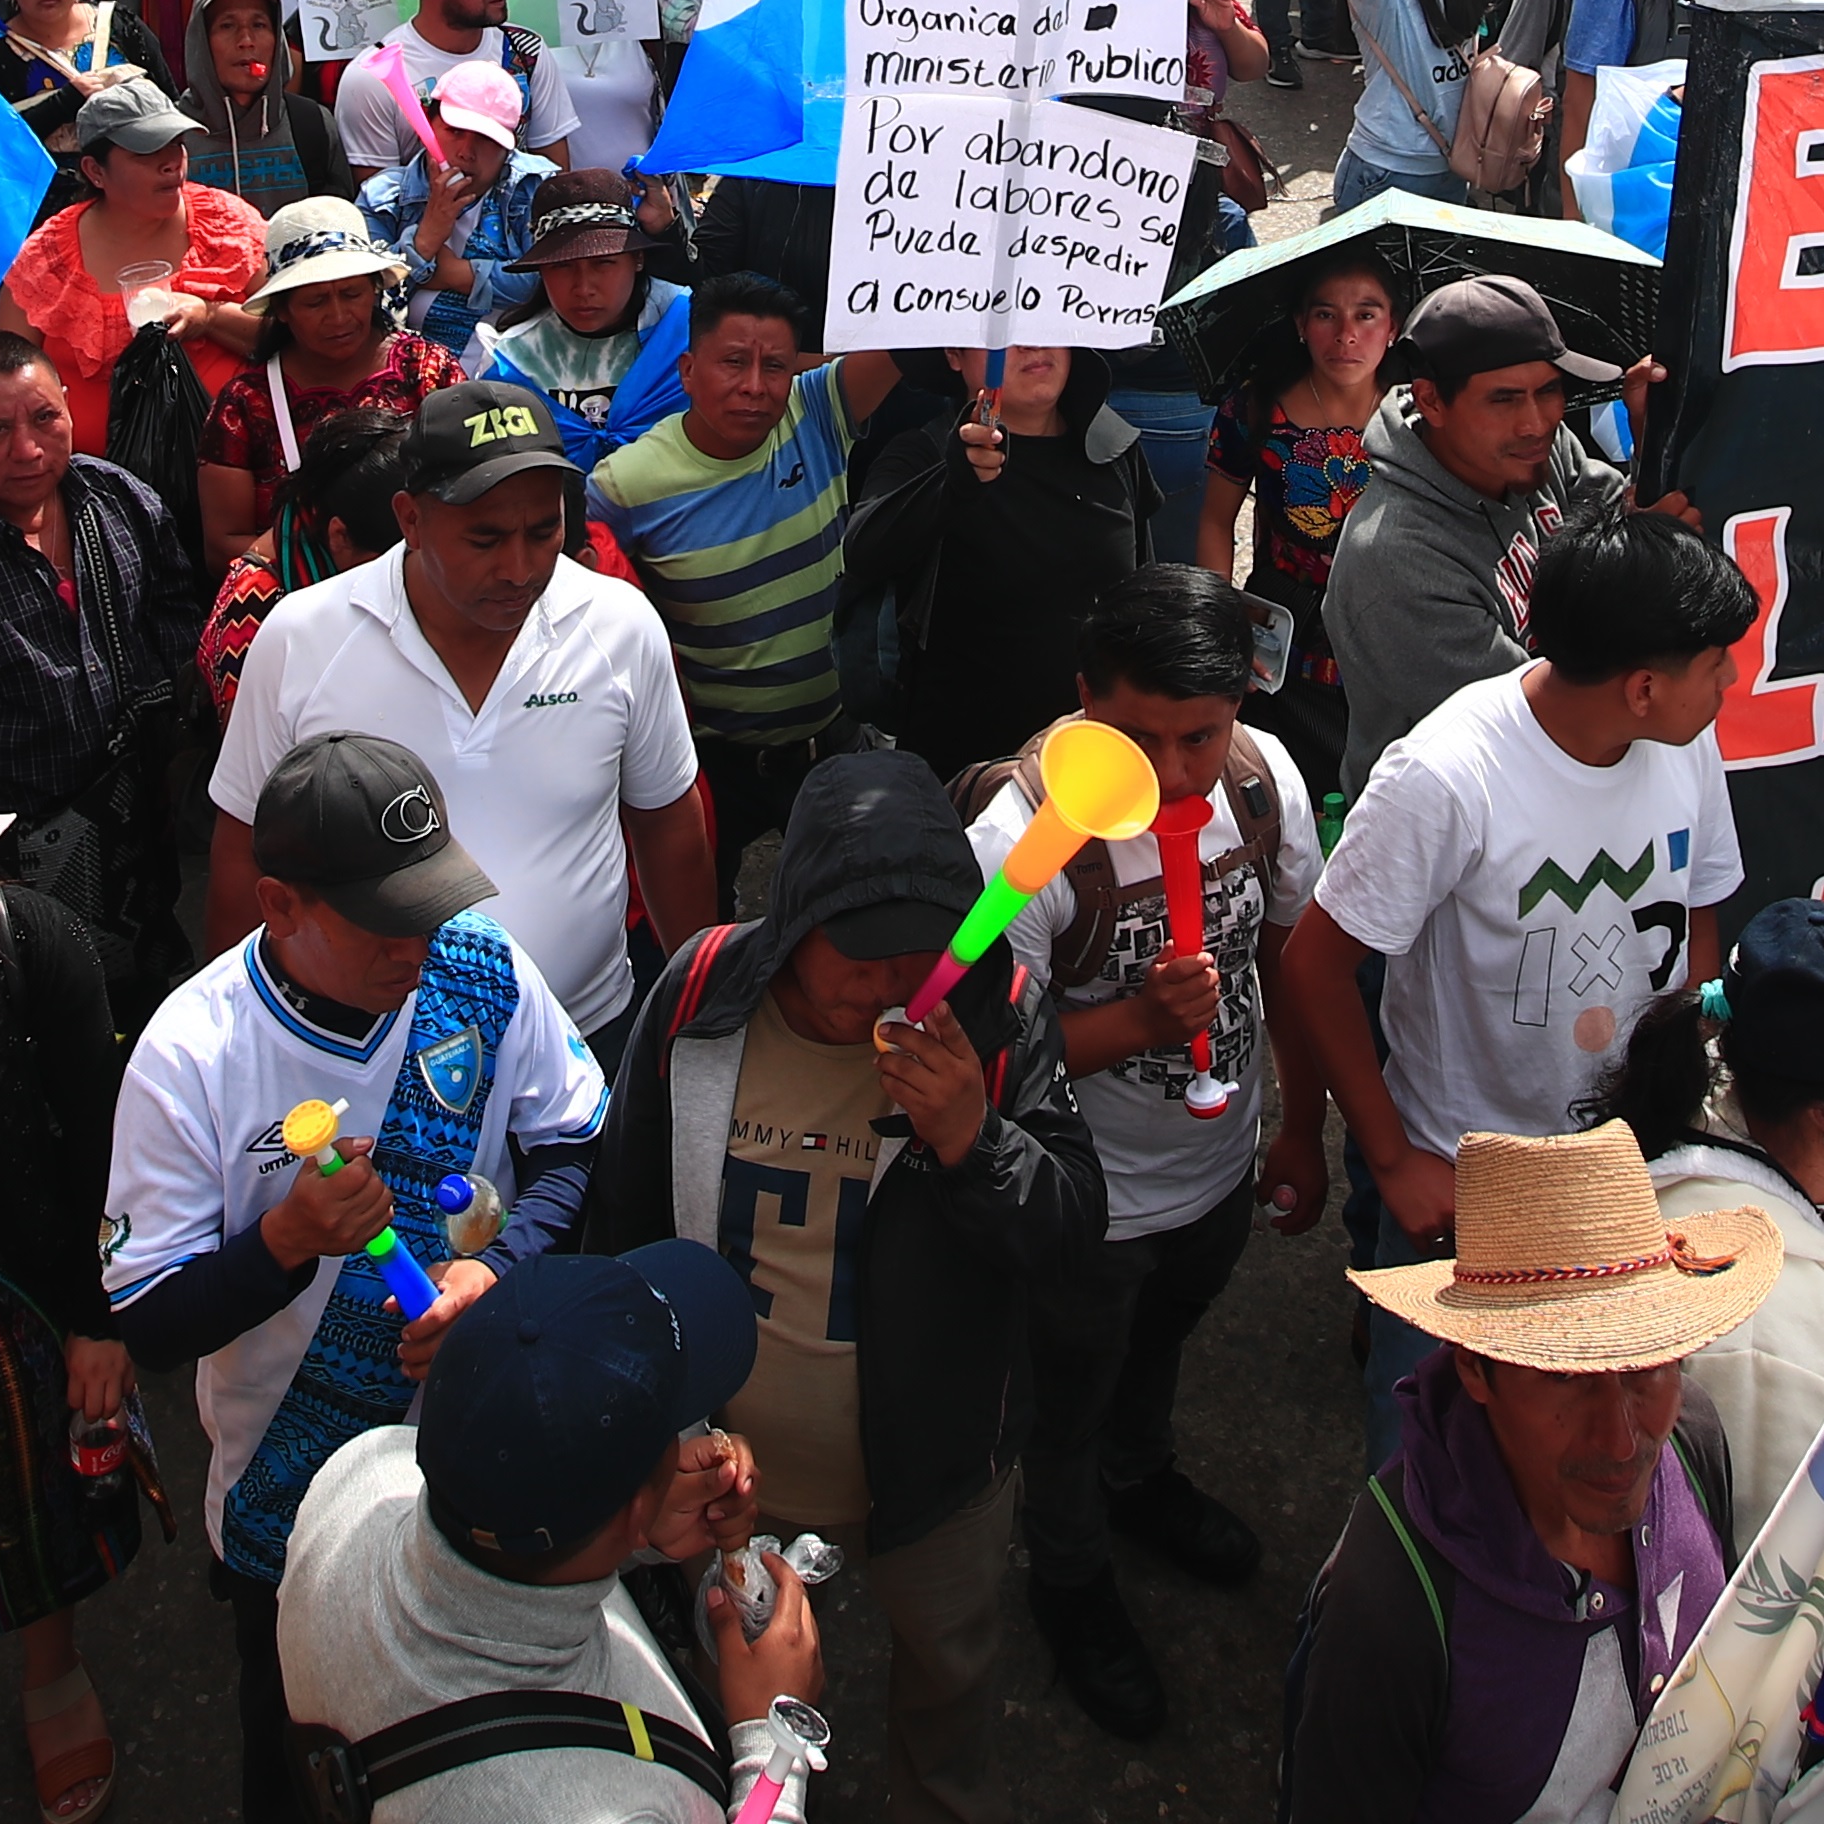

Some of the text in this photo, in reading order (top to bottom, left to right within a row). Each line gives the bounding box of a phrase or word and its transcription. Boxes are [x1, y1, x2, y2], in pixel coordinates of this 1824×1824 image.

[964, 118, 1181, 204] abandono
[865, 159, 1122, 230] de labores
[1007, 222, 1150, 277] despedir
[525, 691, 578, 708] ALSCO
[430, 1042, 472, 1067] GUATEMALA
[729, 1118, 794, 1150] MMY
